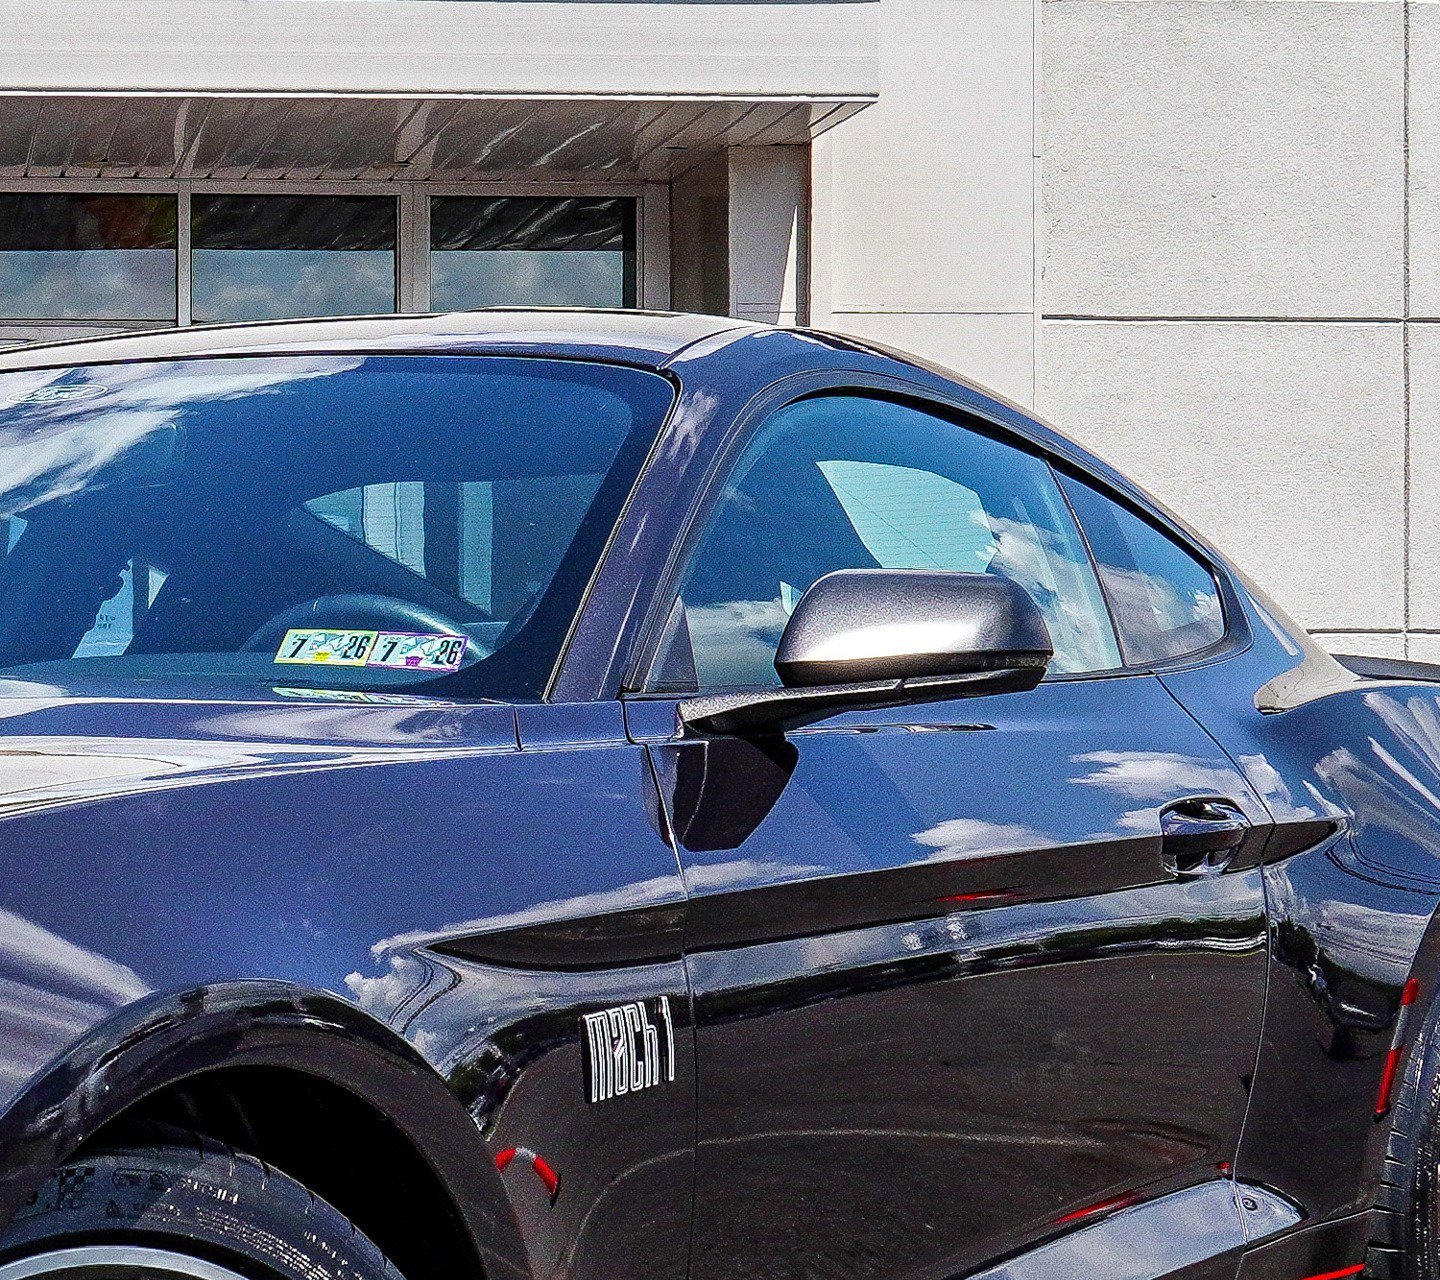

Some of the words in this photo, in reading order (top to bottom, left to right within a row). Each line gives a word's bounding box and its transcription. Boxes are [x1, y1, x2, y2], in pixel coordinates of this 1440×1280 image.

[288, 638, 309, 658] 7
[342, 635, 371, 659] 26
[380, 641, 398, 662] 7
[432, 640, 462, 665] 26
